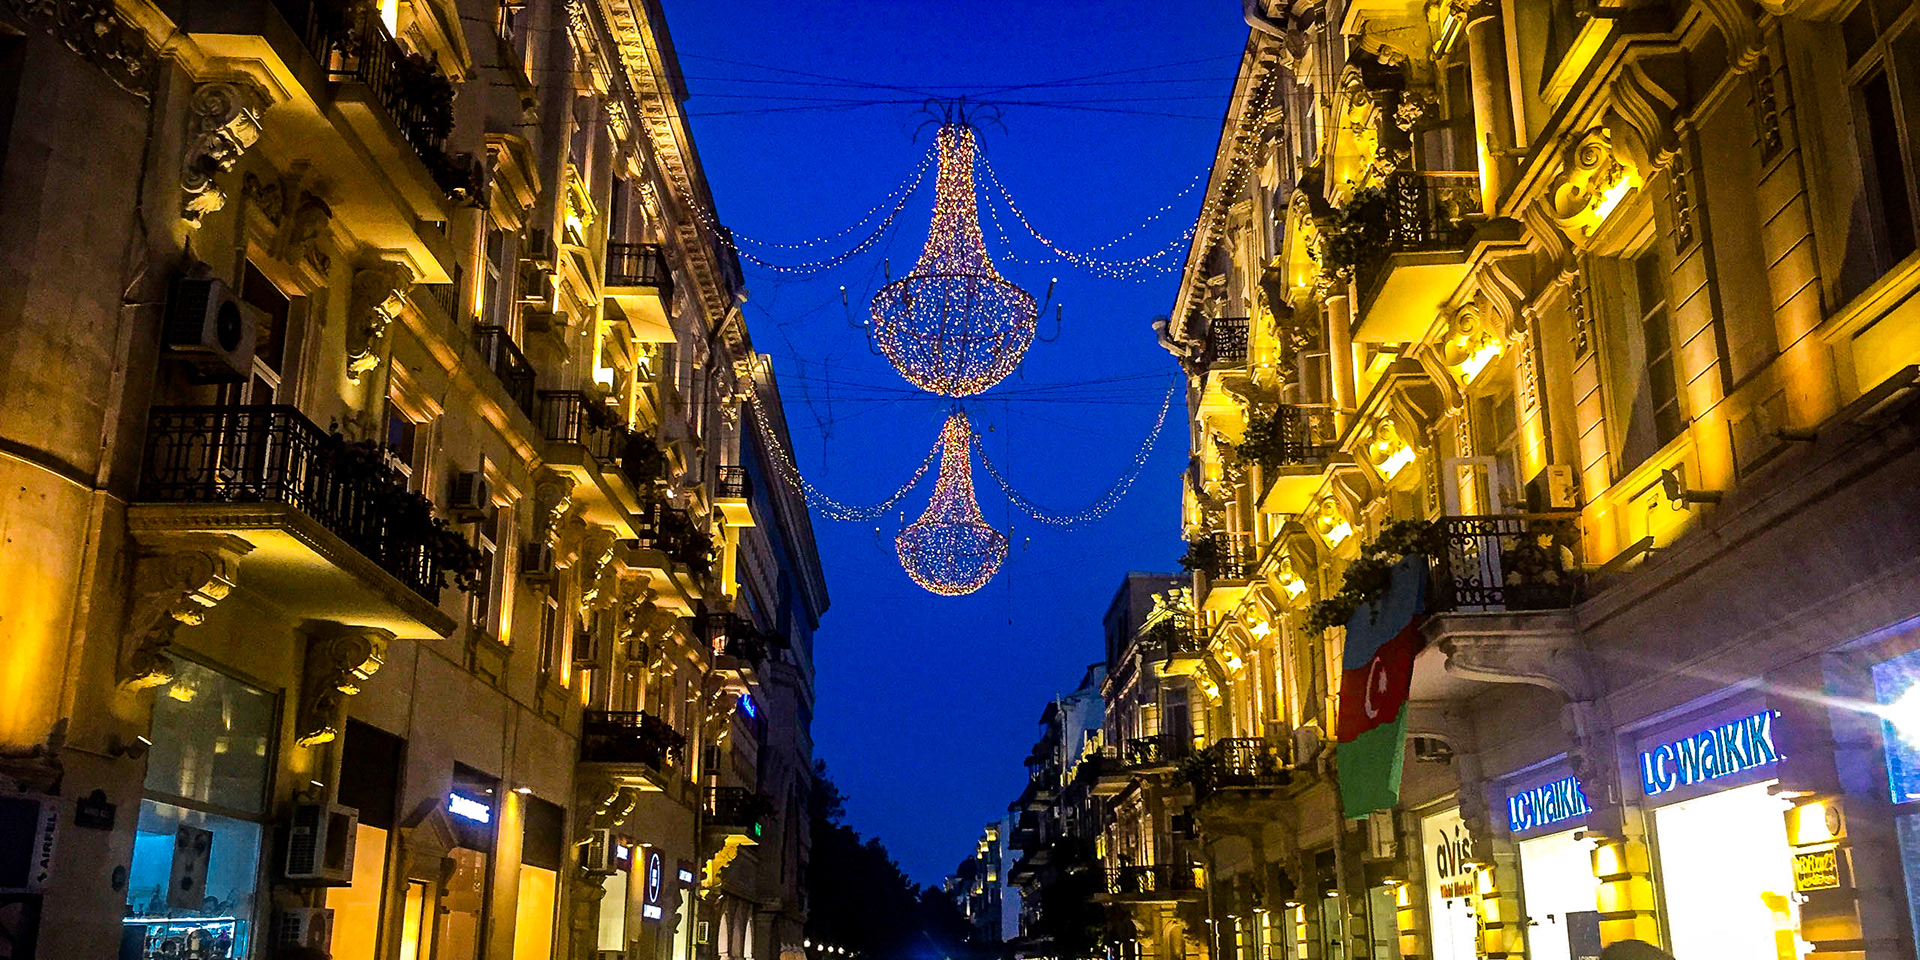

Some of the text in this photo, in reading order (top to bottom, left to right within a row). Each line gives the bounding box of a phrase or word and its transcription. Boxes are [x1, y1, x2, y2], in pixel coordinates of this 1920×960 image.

[1640, 744, 1677, 796] LC
[1507, 793, 1532, 832] LC
[40, 813, 57, 868] AIRFEL
